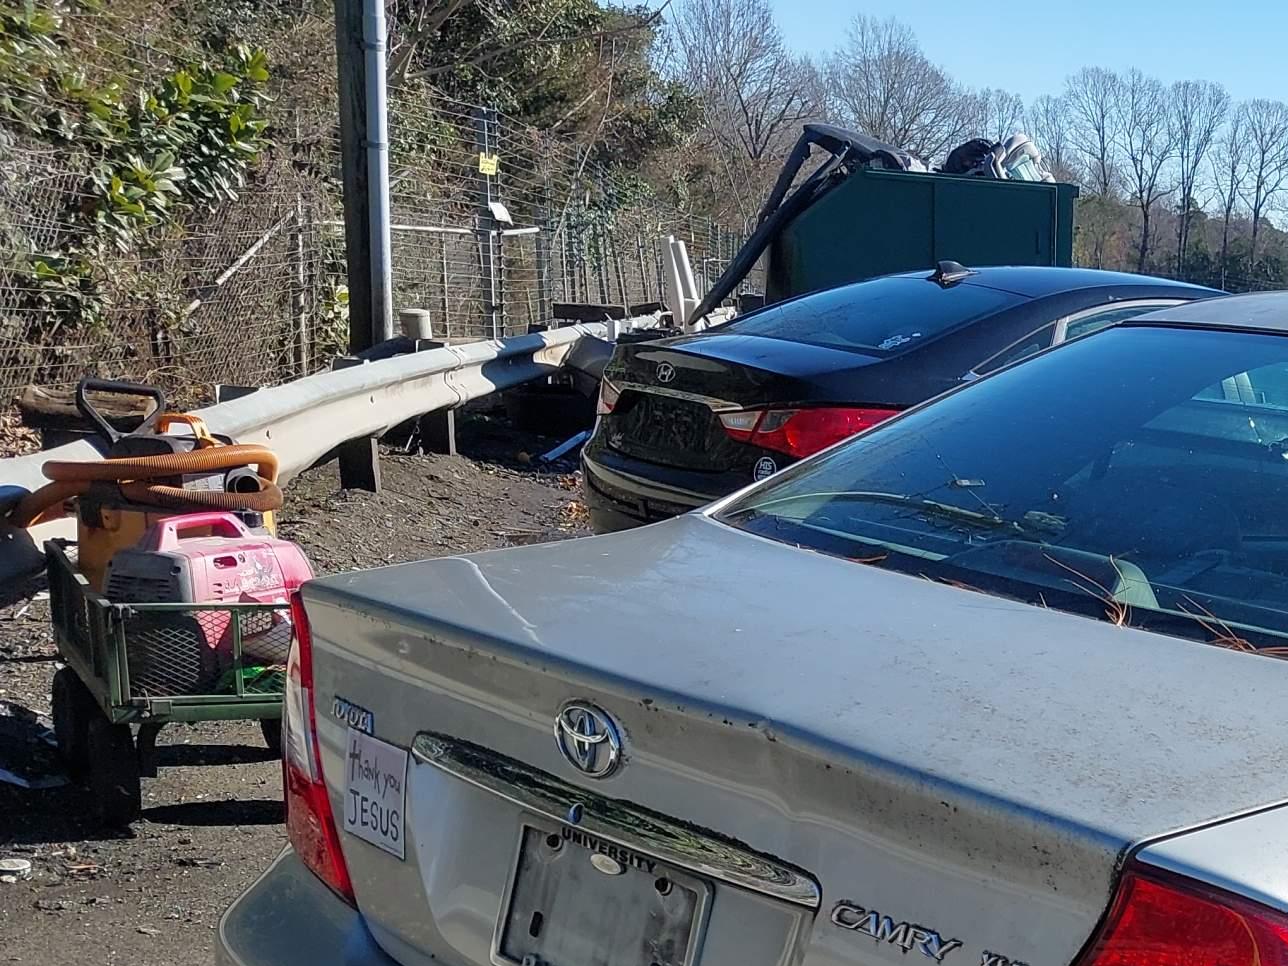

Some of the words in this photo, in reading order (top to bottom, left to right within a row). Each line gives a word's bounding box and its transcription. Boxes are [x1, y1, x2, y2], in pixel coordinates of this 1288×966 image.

[330, 698, 373, 734] TOYOTA
[382, 773, 401, 799] you
[348, 788, 400, 842] JESUS
[562, 827, 656, 873] UNIVERSITY
[831, 903, 963, 961] CAMRY
